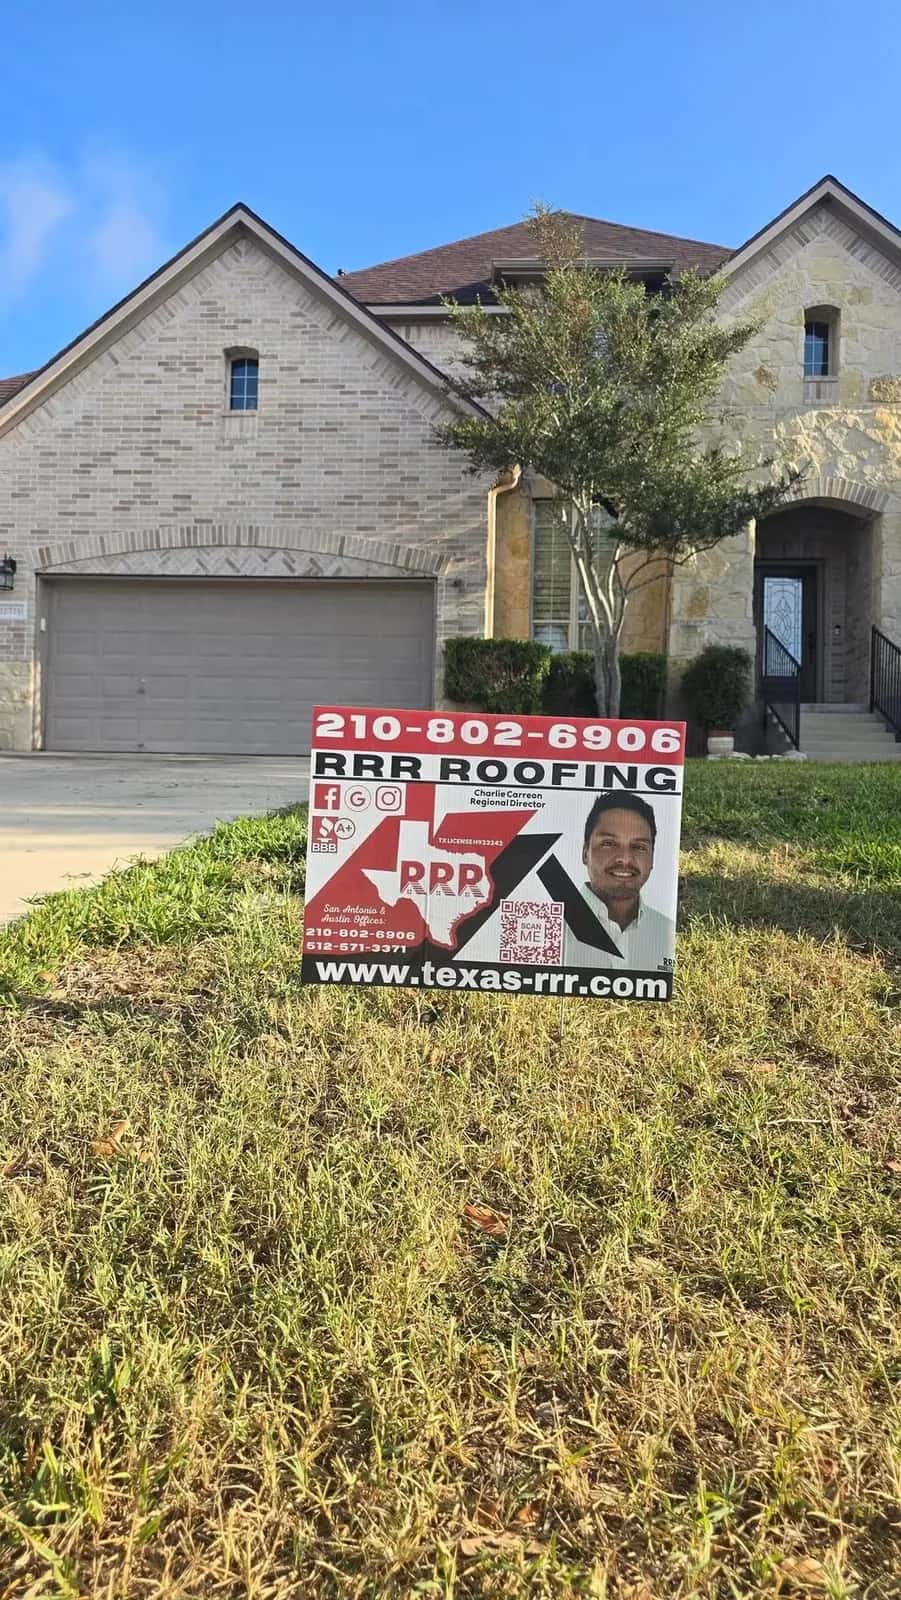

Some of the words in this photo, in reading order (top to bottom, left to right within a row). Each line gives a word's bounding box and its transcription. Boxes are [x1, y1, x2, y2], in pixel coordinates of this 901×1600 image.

[315, 712, 681, 754] 210-802-6906
[315, 752, 422, 780] RRR
[439, 757, 677, 791] ROOFING
[474, 789, 506, 798] Charlie
[506, 790, 543, 799] Carreon
[470, 797, 509, 807] Regional
[509, 799, 546, 808] Director
[312, 843, 337, 852] BBB
[400, 861, 485, 898] RRR
[323, 903, 340, 913] San
[342, 905, 377, 915] Antonio
[321, 914, 351, 923] Austin
[521, 922, 541, 930] SCAN
[306, 928, 415, 940] 210-802-6906
[520, 931, 541, 943] ME
[306, 941, 407, 953] 512-571-3371
[316, 961, 668, 999] www.texas-rrr.com
